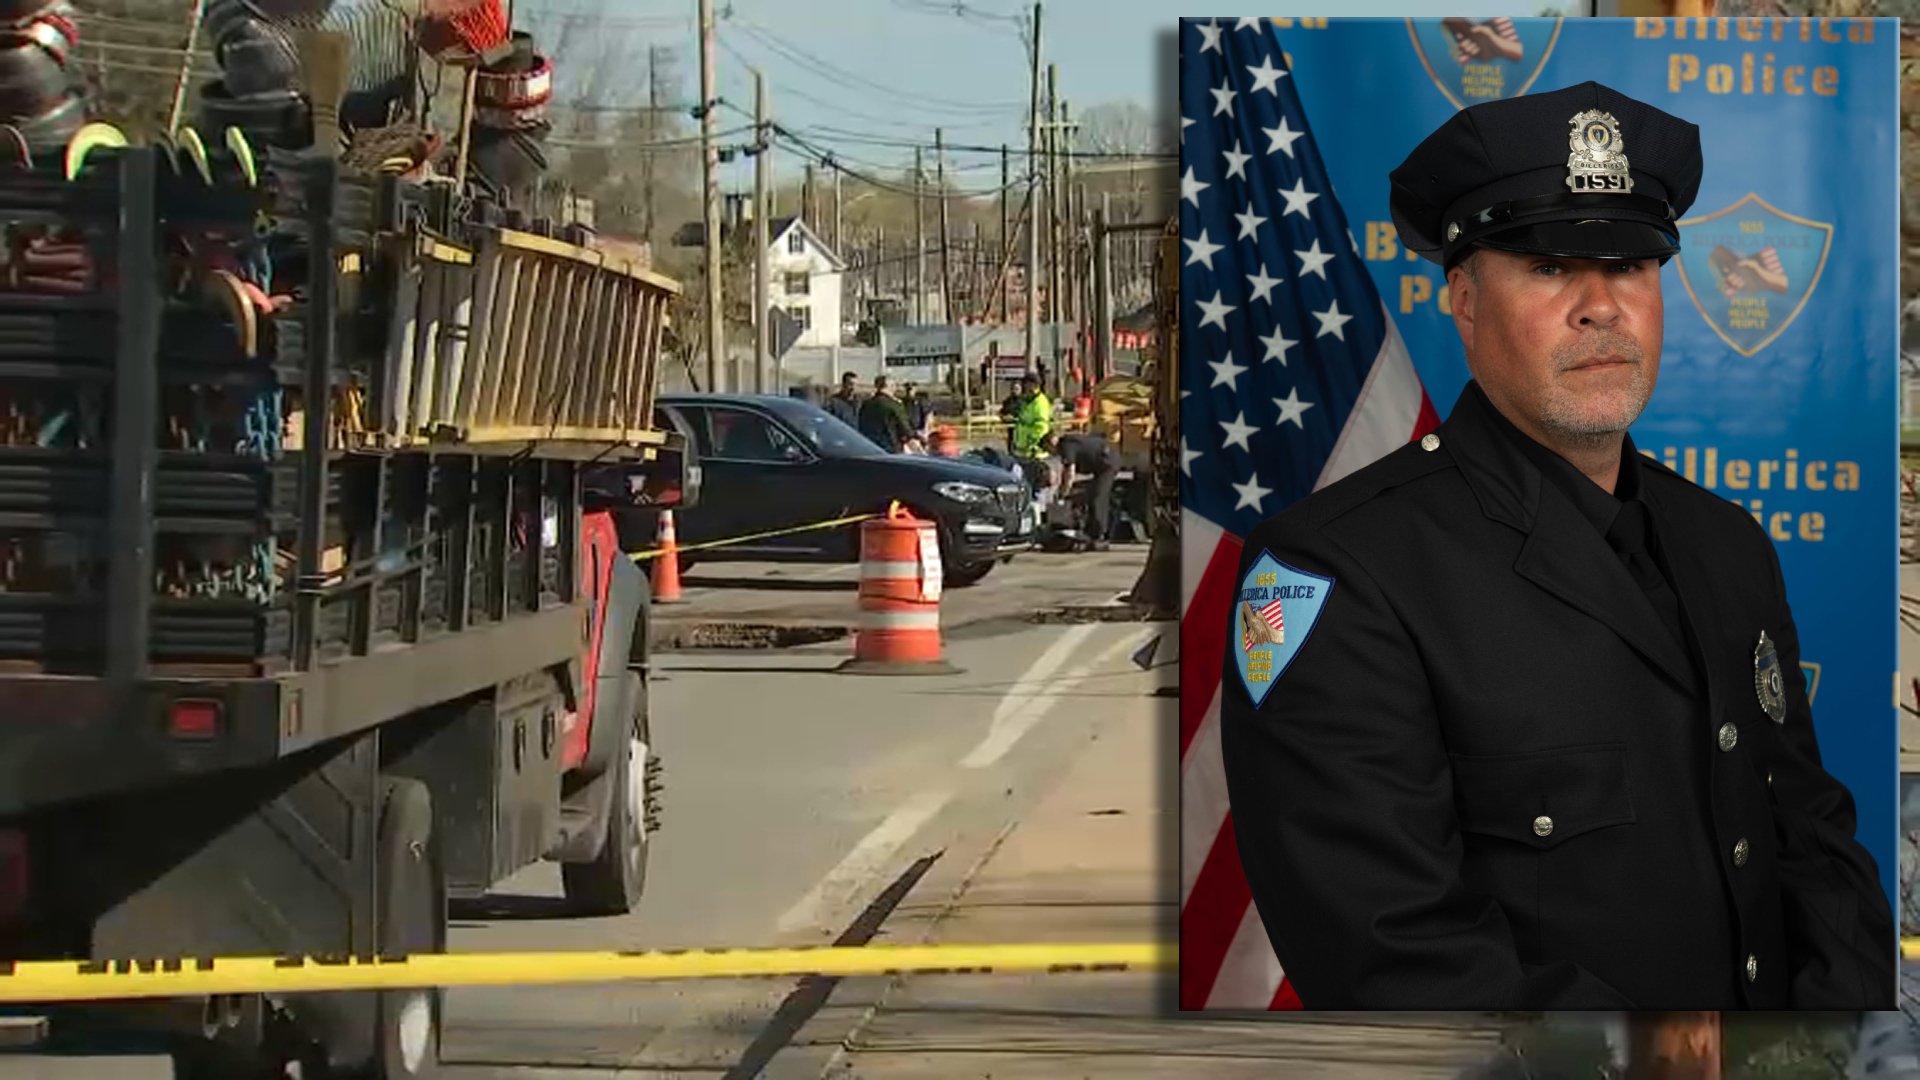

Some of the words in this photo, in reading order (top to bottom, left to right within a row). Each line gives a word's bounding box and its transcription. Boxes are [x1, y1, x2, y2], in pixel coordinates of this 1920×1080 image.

[1668, 52, 1839, 96] Police
[1582, 172, 1621, 190] 159
[1637, 447, 1861, 492] illerica
[1272, 585, 1315, 600] POLICE
[1248, 650, 1272, 660] PEOPLE
[1247, 672, 1271, 682] PEOPLE
